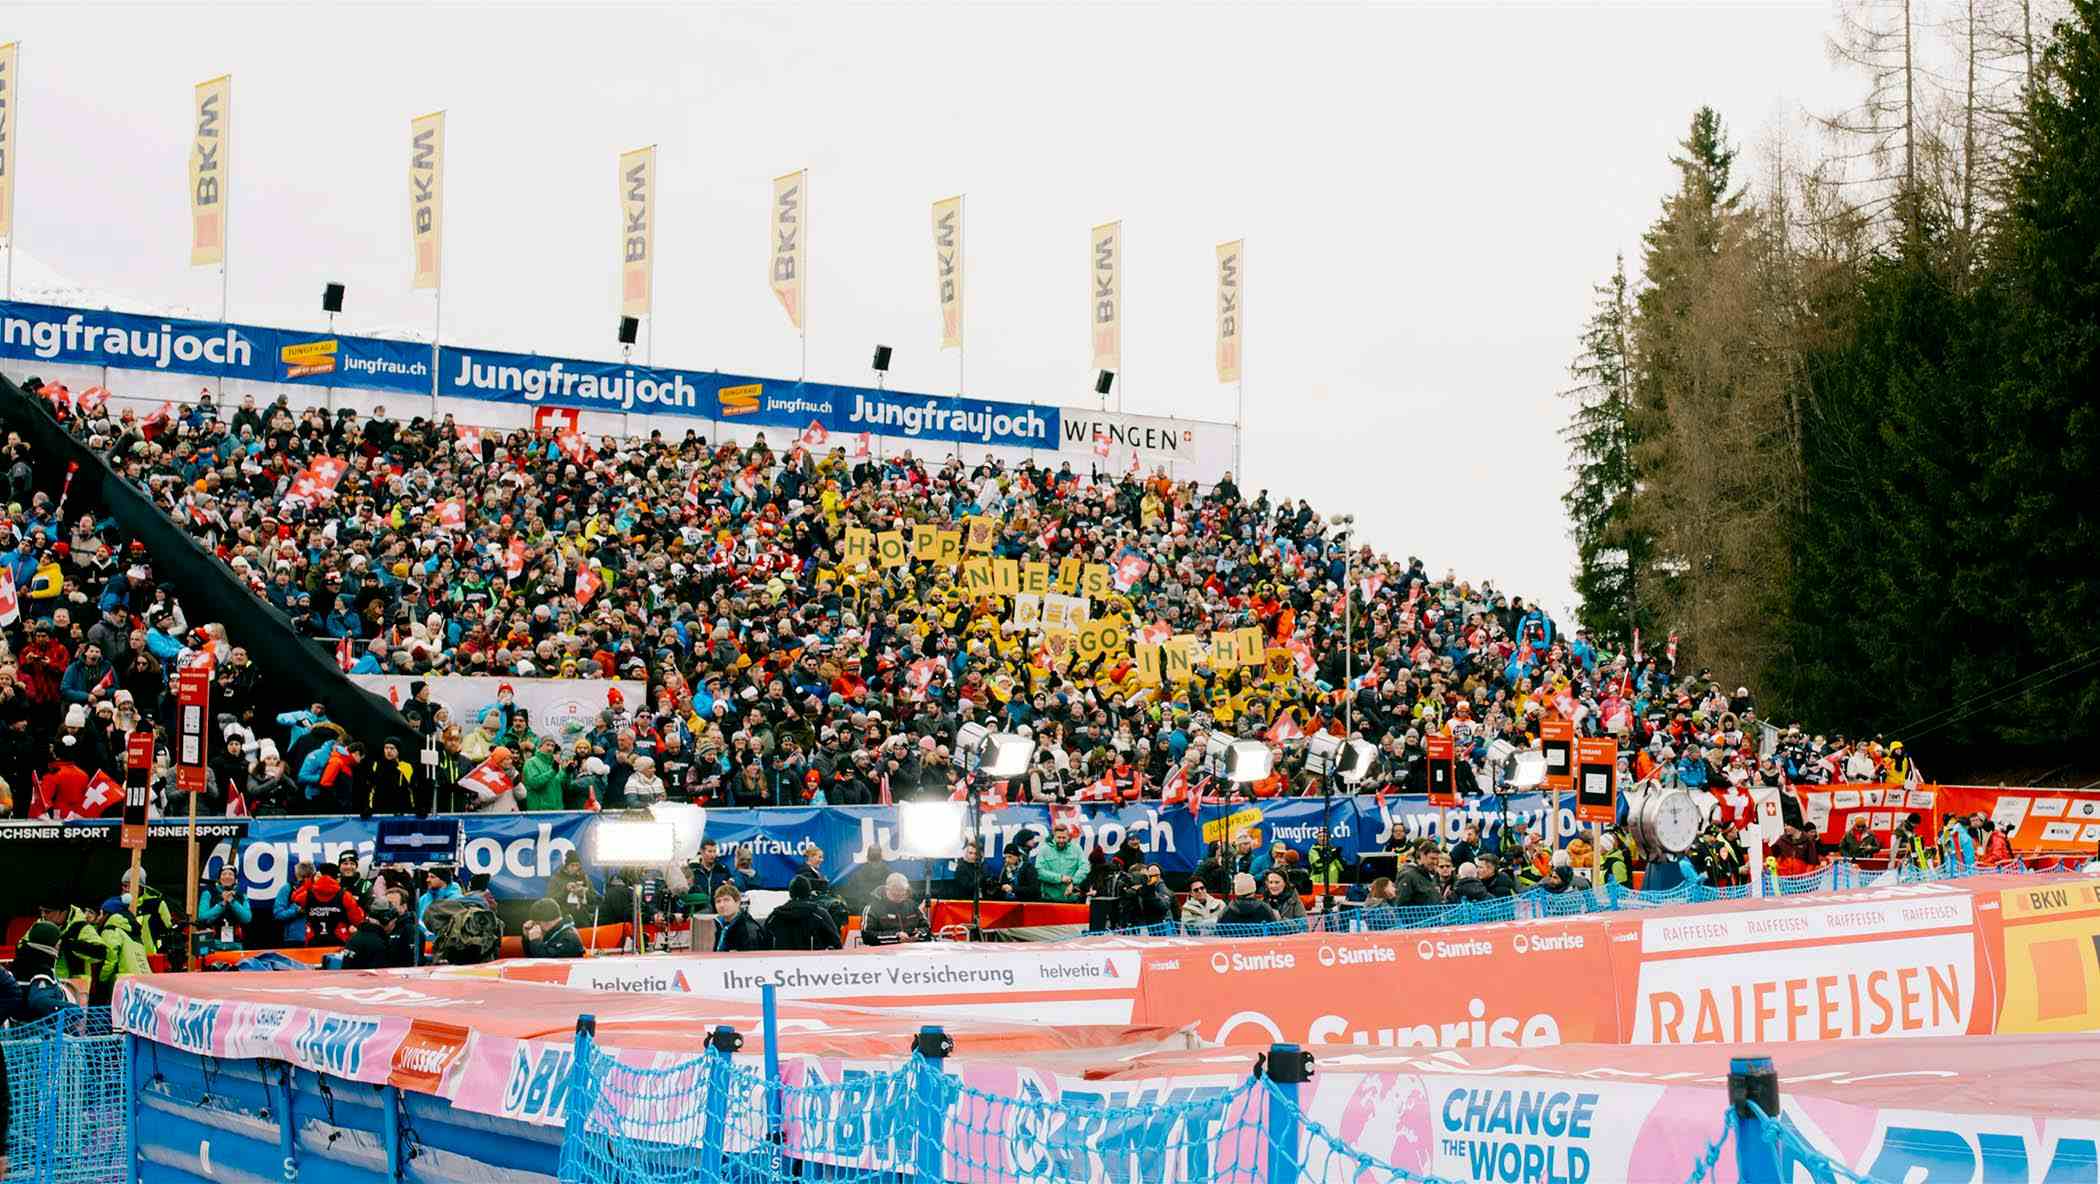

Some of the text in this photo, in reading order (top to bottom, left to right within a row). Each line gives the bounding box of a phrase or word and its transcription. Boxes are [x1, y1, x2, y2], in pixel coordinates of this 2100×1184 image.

[0, 314, 251, 369] ngfraujoch
[344, 354, 427, 375] jungfrau.ch
[455, 355, 696, 409] Jungfraujoch
[767, 396, 832, 413] jungfrau.ch
[849, 395, 1046, 440] Jungfraujoch
[1064, 419, 1178, 450] WENGEN
[849, 533, 956, 558] HOPP
[971, 564, 1102, 592] NIELS
[1081, 628, 1118, 651] GO
[0, 826, 110, 839] CHSNER SPORT
[147, 825, 239, 837] HSNER SPORT
[717, 834, 816, 858] ungfrau.ch
[2031, 889, 2068, 910] BKW
[1825, 911, 1886, 929] RAIFFEISEN
[1902, 905, 1958, 922] RAIFFEISEN
[1664, 922, 1729, 942] RAIFFEISEN
[1747, 916, 1809, 935] RAIFFEISEN
[1436, 938, 1493, 959] Sunrise
[1531, 932, 1585, 951] Sunrise
[1232, 950, 1295, 971] Sunrise
[1338, 944, 1396, 965] Sunrise
[723, 962, 1014, 989] Ihre Schweizer Versicherung
[1040, 963, 1100, 978] helvetia
[1648, 962, 1963, 1044] RAIFFEISEN
[1442, 1088, 1600, 1138] CHANGE
[1441, 1139, 1590, 1184] THE WORLD
